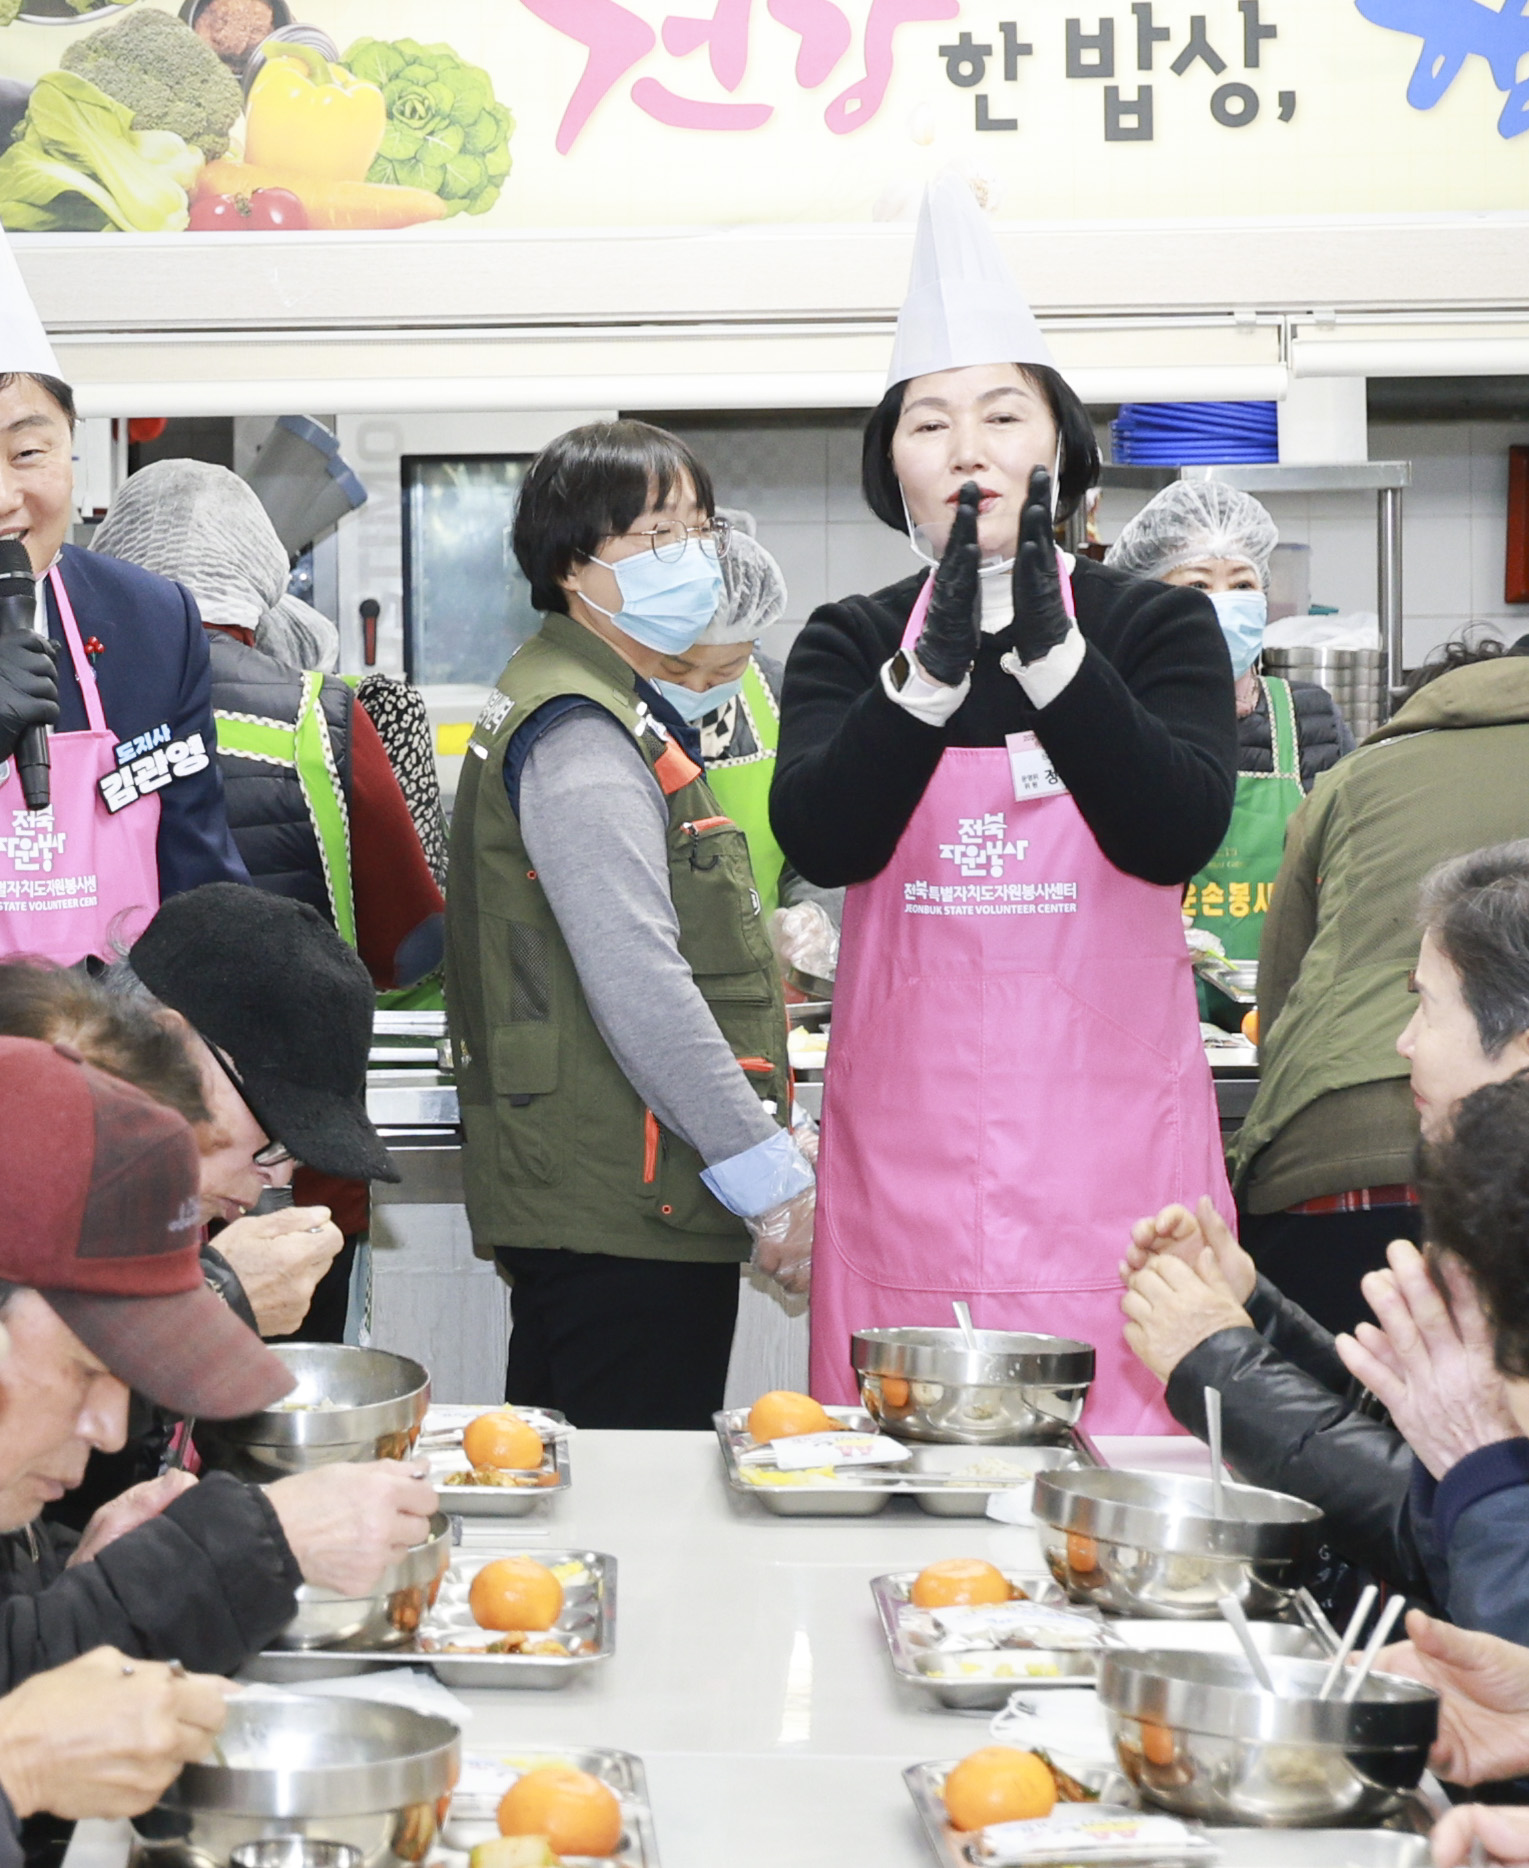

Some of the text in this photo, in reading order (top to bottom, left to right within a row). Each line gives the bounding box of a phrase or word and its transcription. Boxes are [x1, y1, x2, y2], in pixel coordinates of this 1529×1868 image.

[1066, 0, 1297, 142] 밥상,
[115, 723, 172, 765] 도지사
[100, 733, 210, 813] 김관영
[958, 812, 1008, 844] 전북
[939, 839, 1029, 878] 자원봉사
[29, 898, 79, 912] VOLUNTEER
[903, 880, 1078, 903] 전북특별자치도자원봉사센터
[904, 902, 1078, 916] JEONBUK STATE VOLUNTEER CENTER
